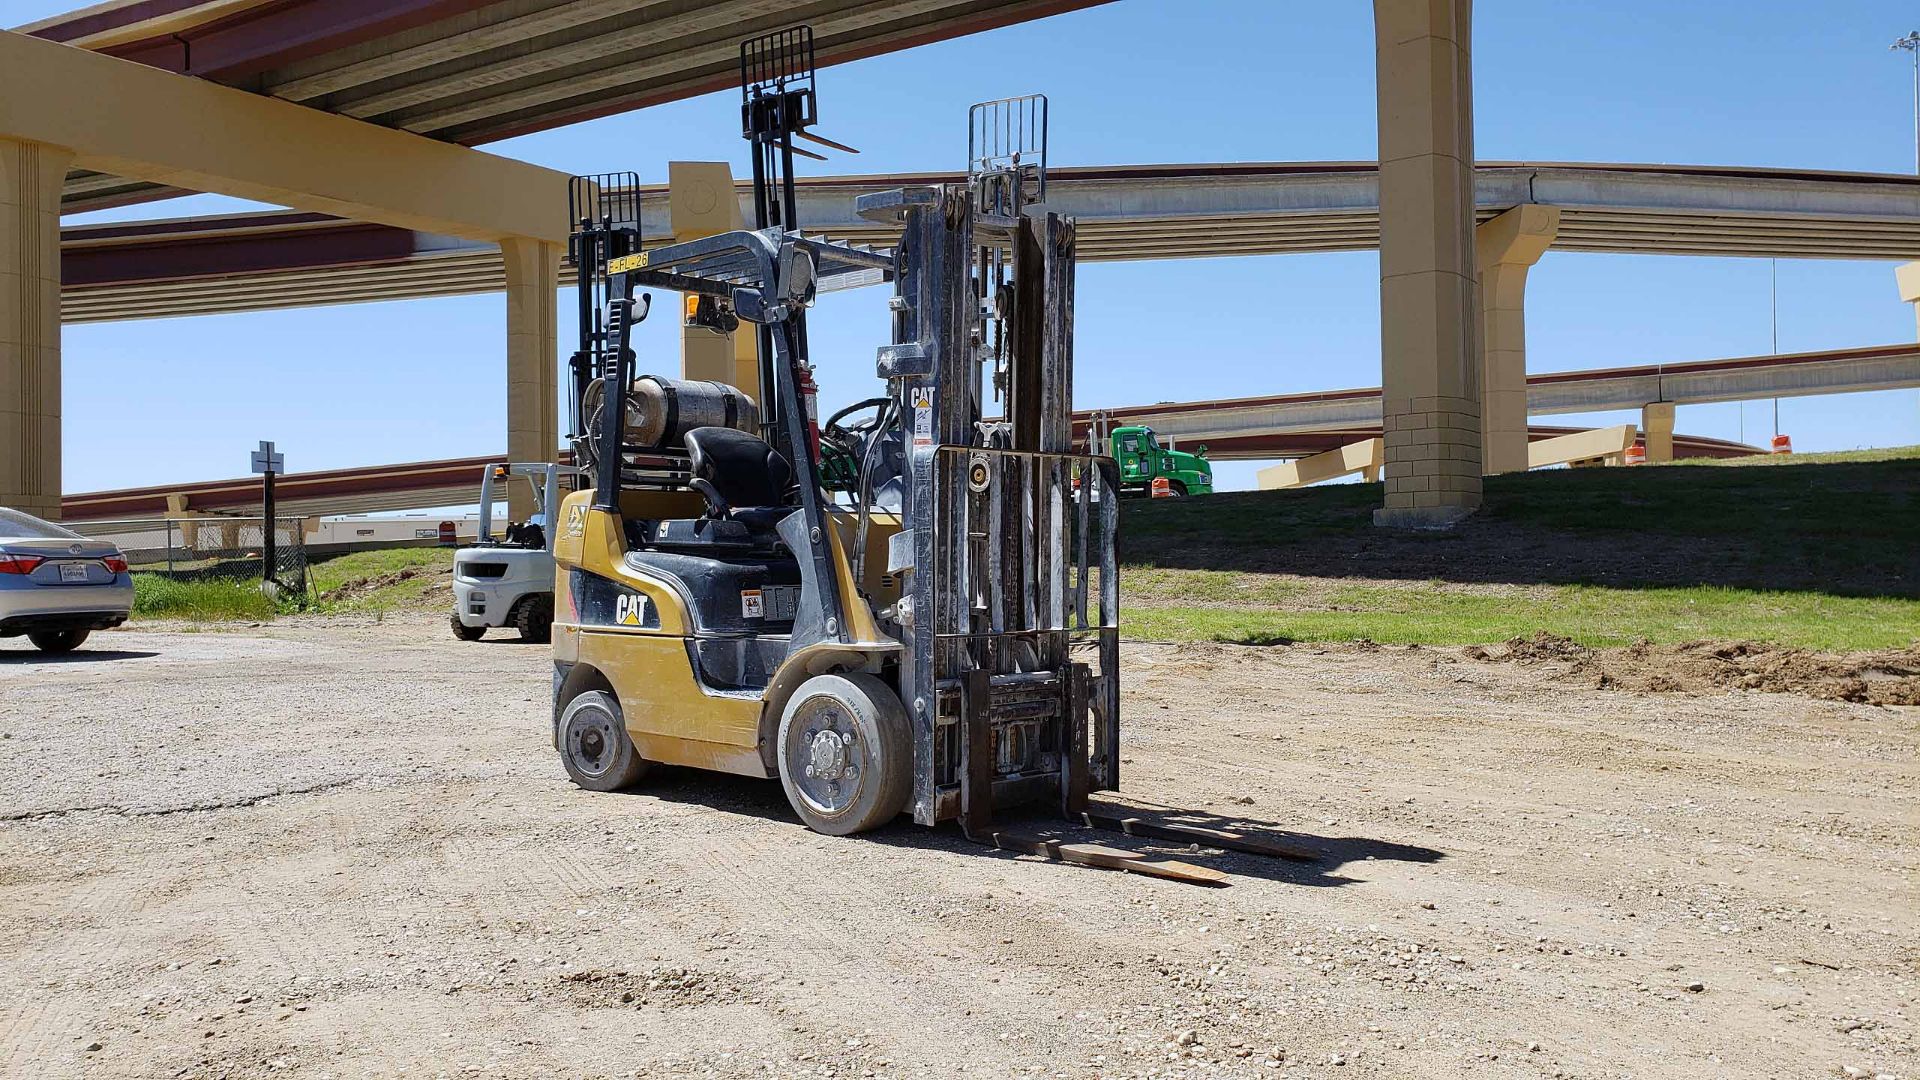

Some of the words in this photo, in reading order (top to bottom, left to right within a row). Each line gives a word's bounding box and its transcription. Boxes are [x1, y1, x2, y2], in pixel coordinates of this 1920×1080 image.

[608, 253, 648, 273] E-FL-26
[911, 386, 935, 409] CAT
[616, 594, 648, 626] CAT
